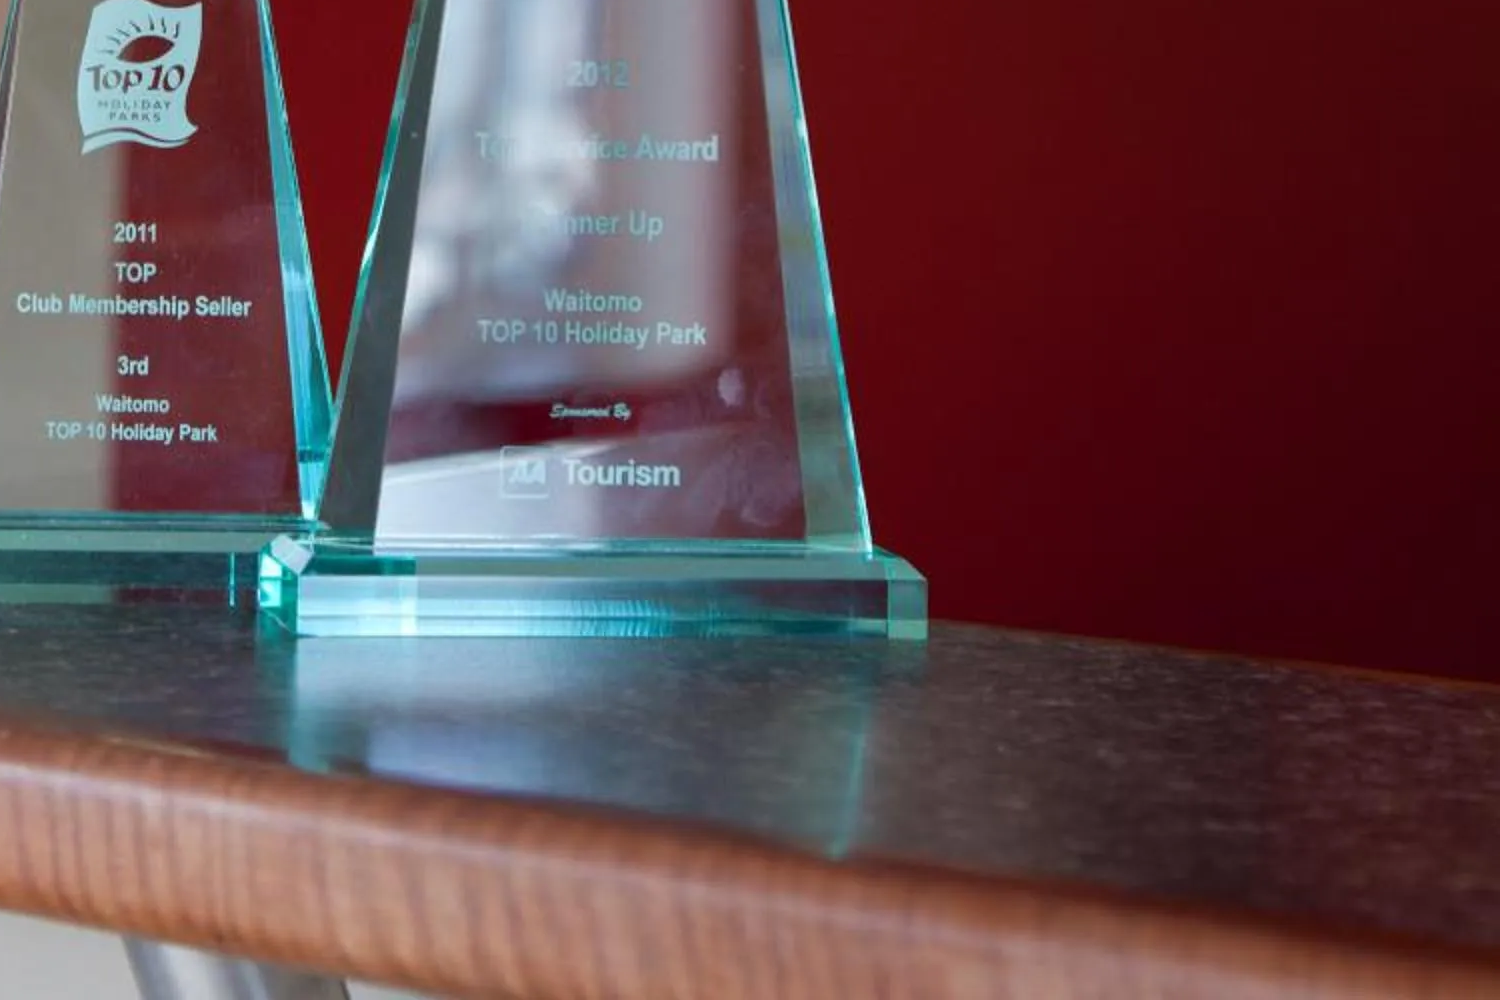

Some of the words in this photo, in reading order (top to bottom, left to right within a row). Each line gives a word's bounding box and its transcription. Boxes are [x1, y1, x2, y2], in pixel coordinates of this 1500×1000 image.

[85, 64, 143, 94] Top
[148, 64, 185, 92] 10
[98, 100, 171, 111] HOLIDAY
[109, 111, 161, 122] PARKS
[635, 134, 719, 162] Award
[113, 222, 158, 244] 2011
[629, 210, 663, 242] Up
[115, 262, 157, 283] TOP
[16, 293, 63, 314] Club
[69, 294, 190, 320] Membership
[195, 296, 252, 317] Seller
[544, 288, 642, 313] Waitomo
[477, 320, 526, 343] TOP
[533, 321, 558, 343] 10
[565, 321, 649, 350] Holiday
[656, 322, 707, 346] Park
[117, 356, 149, 376] 3rd
[95, 394, 170, 414] Waitomo
[46, 421, 82, 440] TOP
[87, 422, 106, 440] 10
[111, 423, 174, 445] Holiday
[179, 424, 218, 443] Park
[562, 458, 681, 487] Tourism
